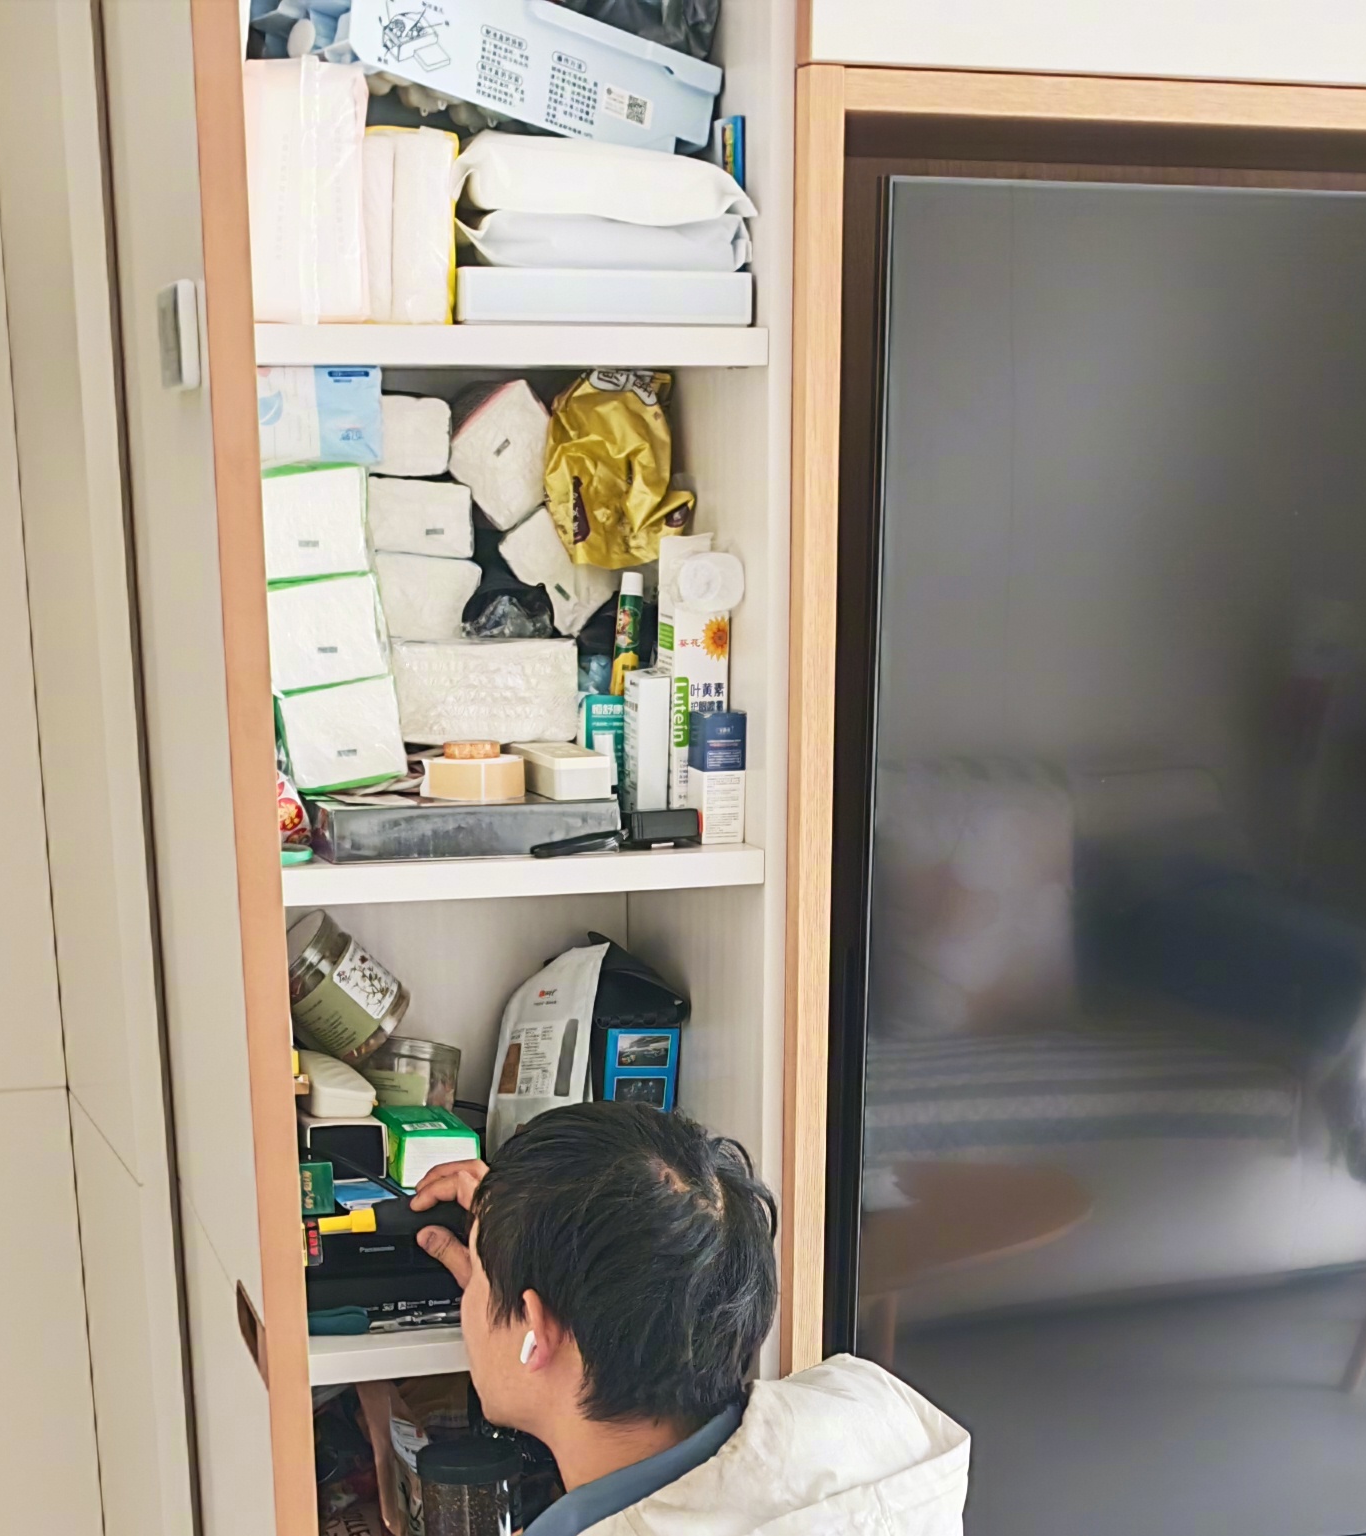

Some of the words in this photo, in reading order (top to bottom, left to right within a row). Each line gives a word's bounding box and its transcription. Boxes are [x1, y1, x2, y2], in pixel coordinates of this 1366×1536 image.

[690, 682, 725, 698] 叶黄素
[672, 681, 687, 744] Lutein
